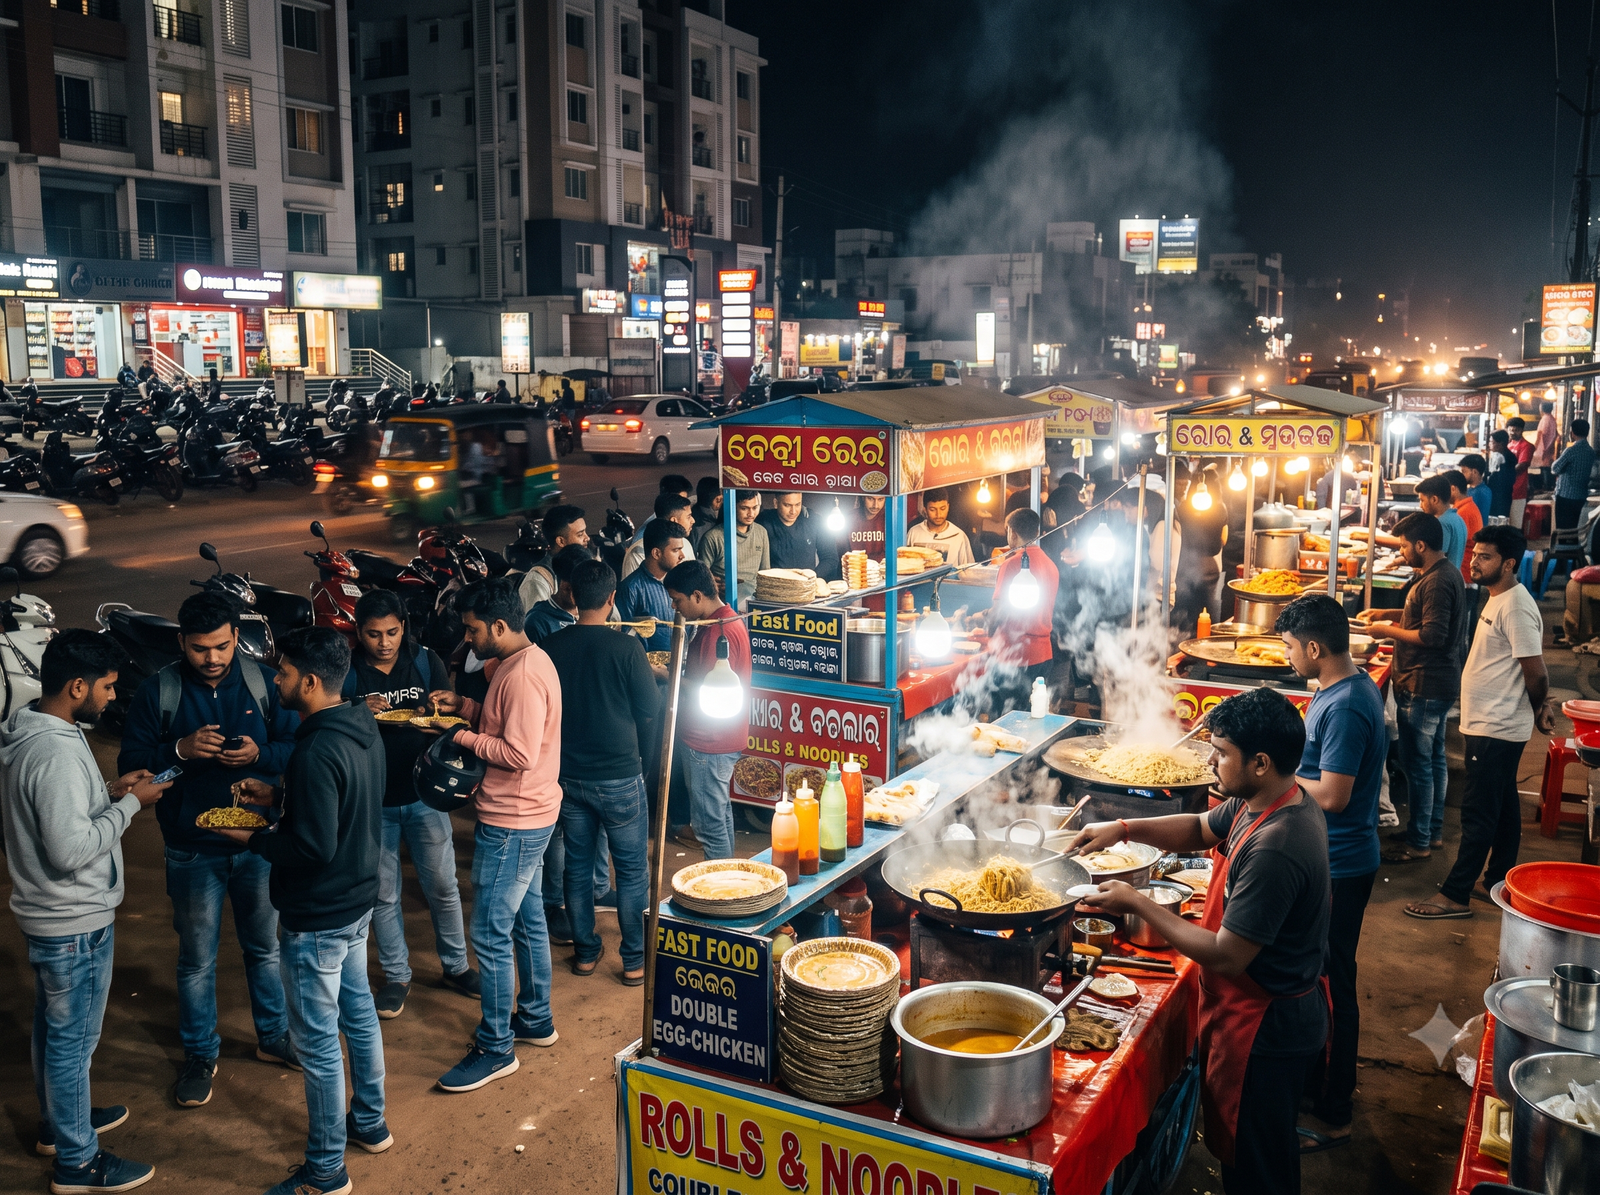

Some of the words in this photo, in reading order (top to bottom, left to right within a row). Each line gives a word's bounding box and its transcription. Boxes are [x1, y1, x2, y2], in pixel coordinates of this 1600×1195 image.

[975, 430, 985, 461] &
[1238, 426, 1254, 446] &
[752, 608, 790, 631] Fast
[795, 613, 838, 637] Food
[789, 702, 804, 733] &
[784, 742, 795, 757] &
[656, 926, 701, 958] FAST
[706, 938, 759, 971] FOOD
[671, 994, 738, 1031] DOUBLE
[653, 1018, 766, 1068] EGG-CHICKEN
[638, 1091, 766, 1178] ROLLS
[777, 1130, 809, 1192] &
